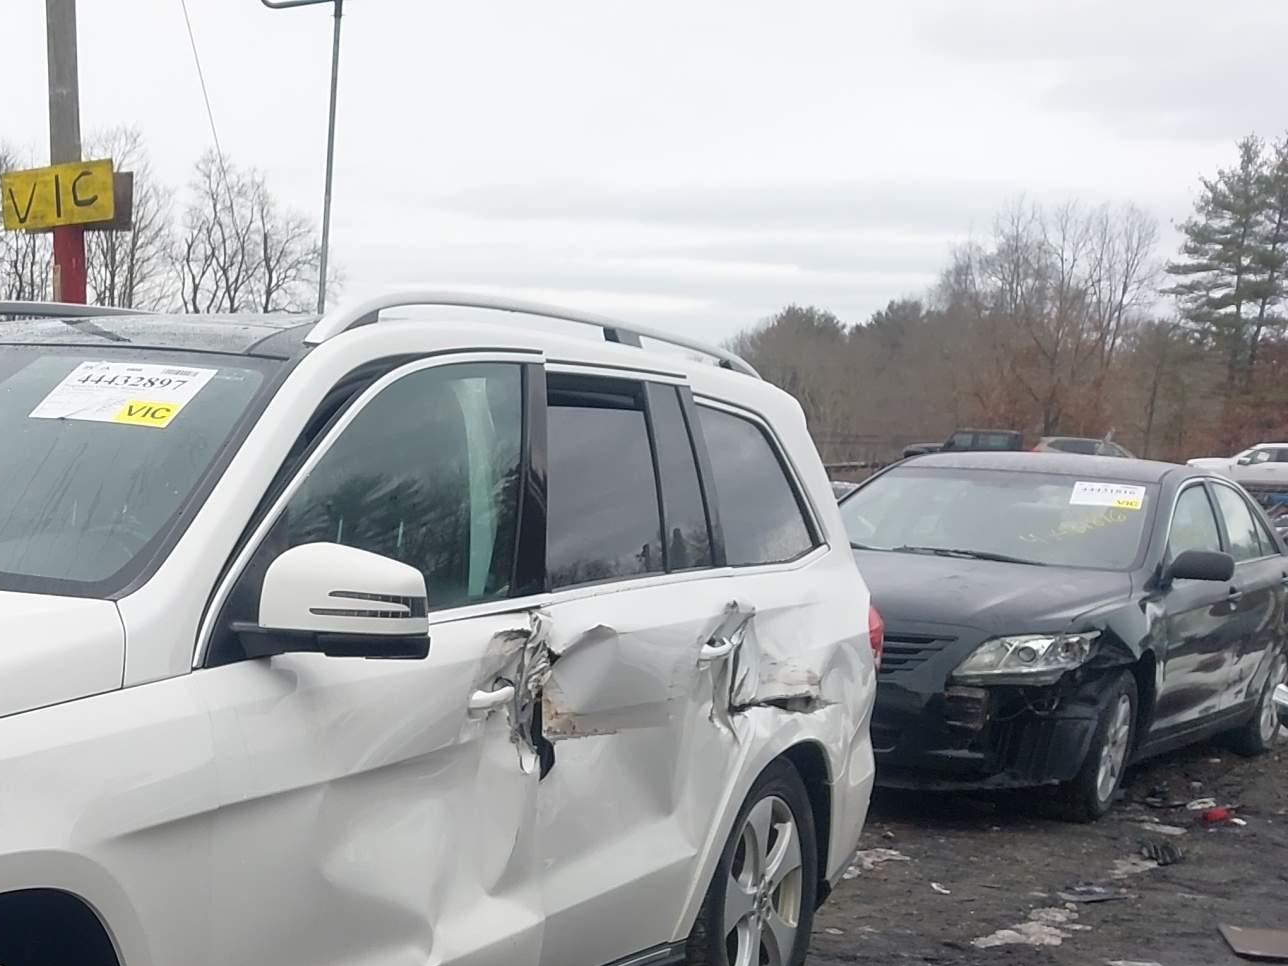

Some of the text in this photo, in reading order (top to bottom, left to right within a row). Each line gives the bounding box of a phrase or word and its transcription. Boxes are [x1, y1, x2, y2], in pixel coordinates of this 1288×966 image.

[9, 171, 98, 223] VIC
[77, 373, 189, 391] 44432897
[127, 404, 171, 420] VIC
